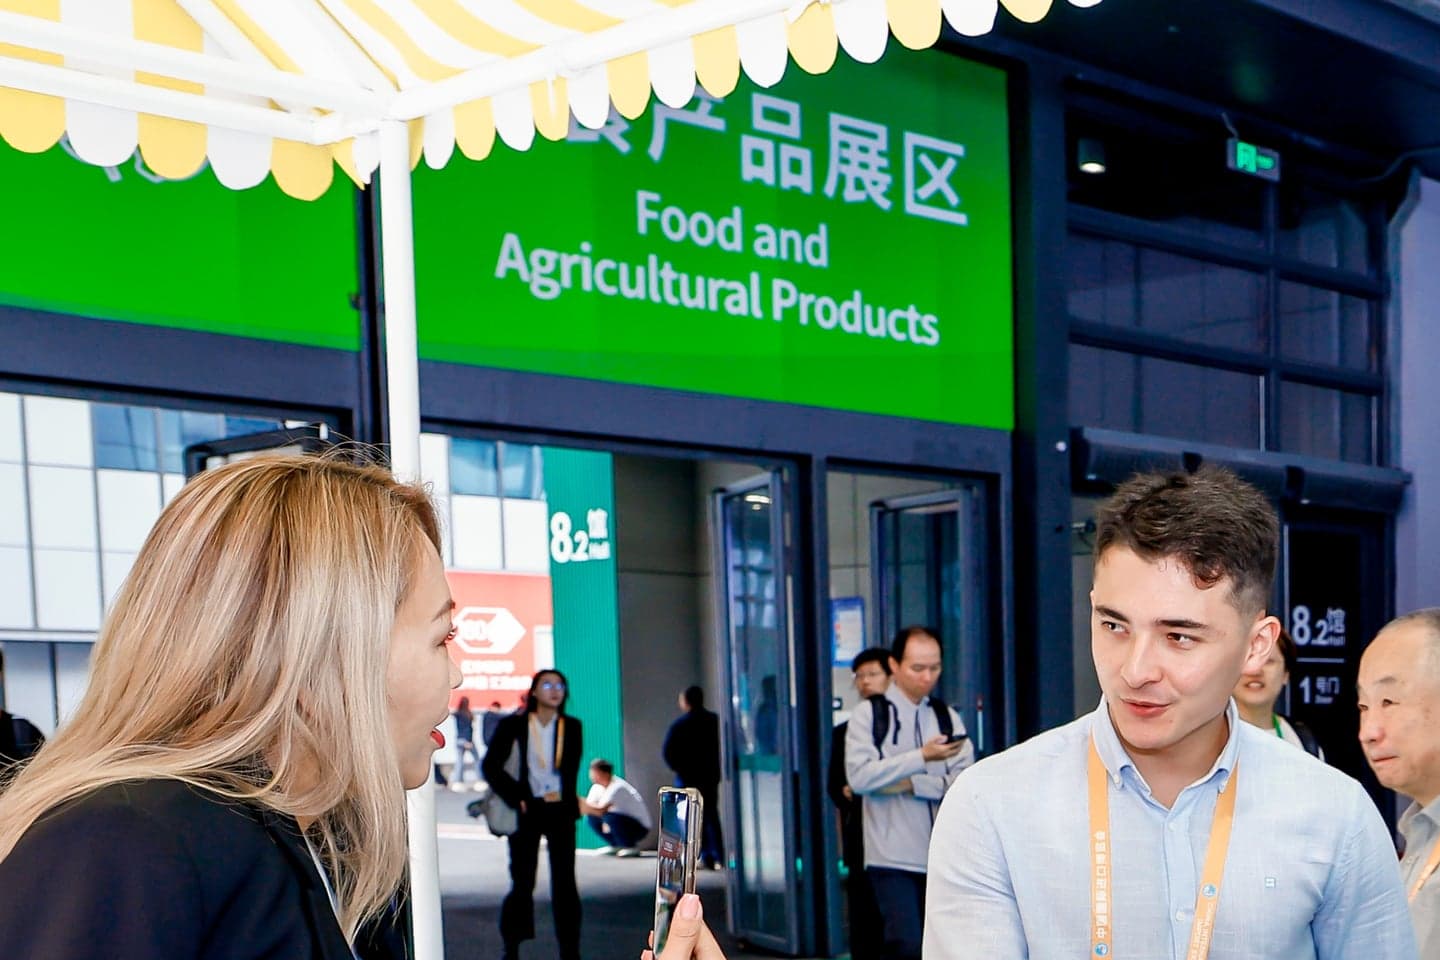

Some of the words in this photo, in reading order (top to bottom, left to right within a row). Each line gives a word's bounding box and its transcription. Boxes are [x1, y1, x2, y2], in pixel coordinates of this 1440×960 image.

[635, 189, 743, 252] Food
[752, 222, 829, 268] and
[494, 231, 763, 319] Agricultural
[771, 277, 940, 346] Products
[550, 511, 589, 564] 8.2
[1292, 604, 1329, 646] 8.2
[1299, 676, 1311, 704] 1
